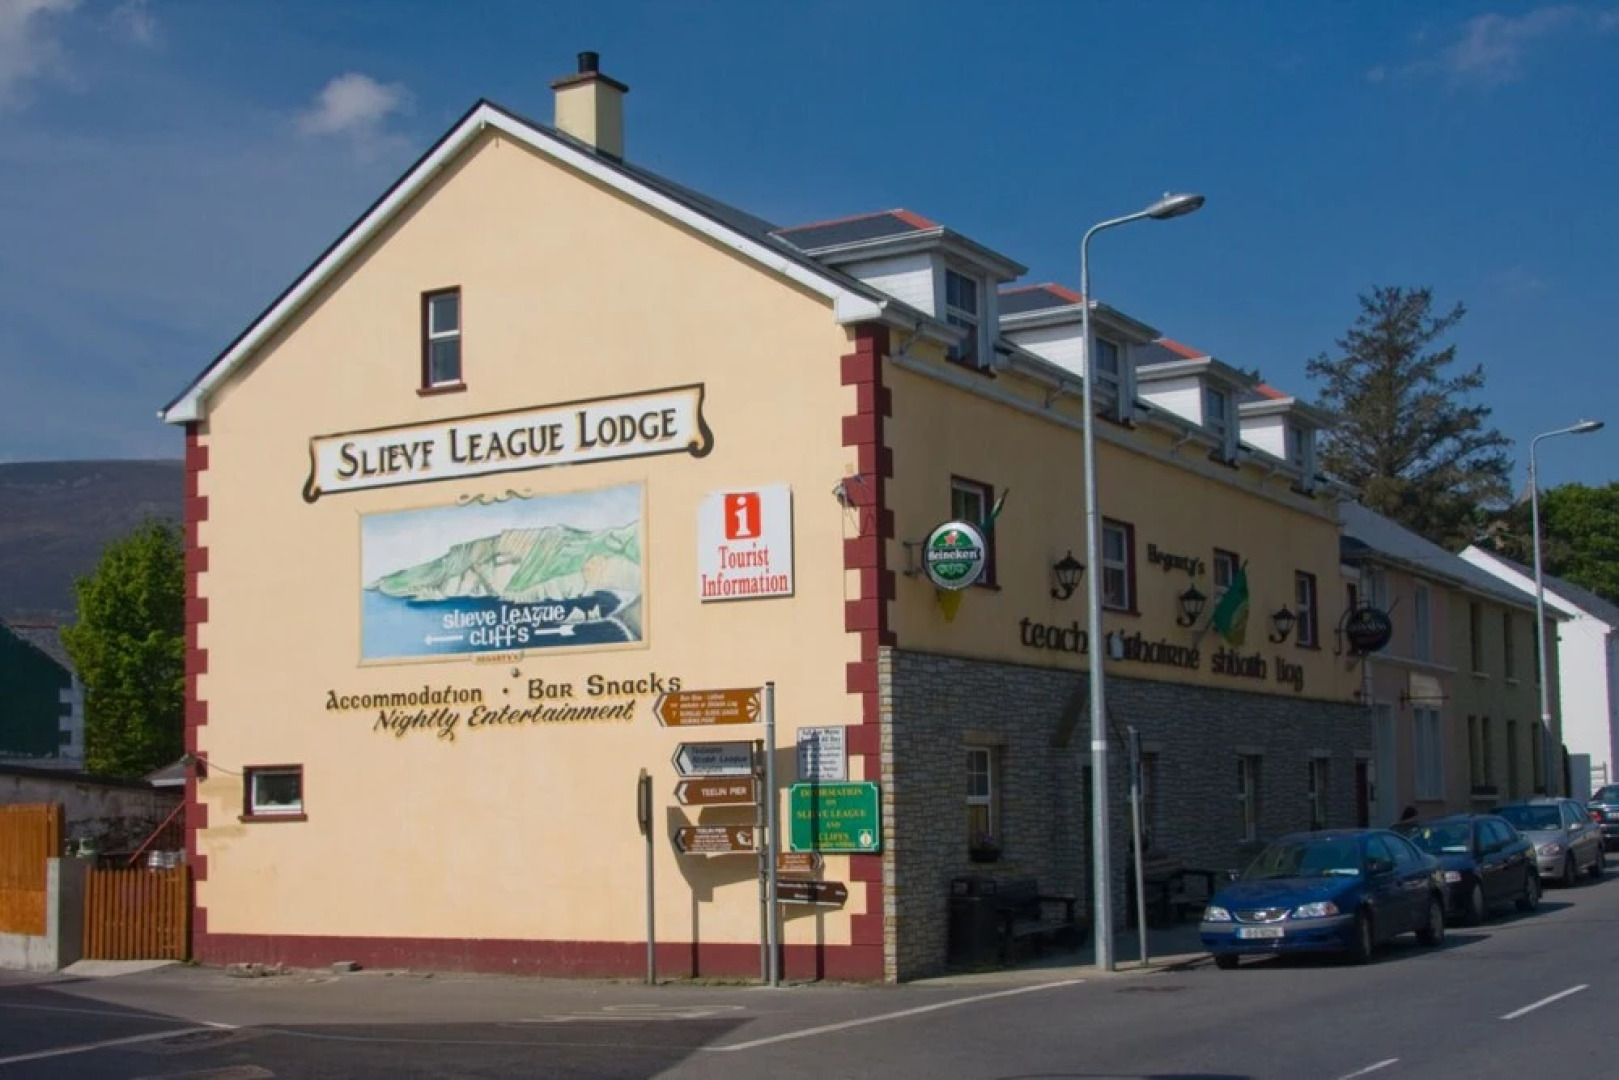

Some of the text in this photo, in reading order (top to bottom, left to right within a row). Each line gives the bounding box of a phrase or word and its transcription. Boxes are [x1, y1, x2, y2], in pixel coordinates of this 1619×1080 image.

[337, 408, 678, 479] SLIEVE LEAGUE LODGE
[718, 542, 769, 569] Tourist
[928, 548, 977, 561] Heineken
[701, 568, 788, 597] Information
[1019, 616, 1088, 655] teach
[326, 685, 482, 710] Accommodation
[587, 672, 680, 697] Snacks
[373, 699, 635, 741] Nightly Entertainment
[701, 786, 747, 797] TEELIN PIER
[800, 787, 863, 797] INORMATION
